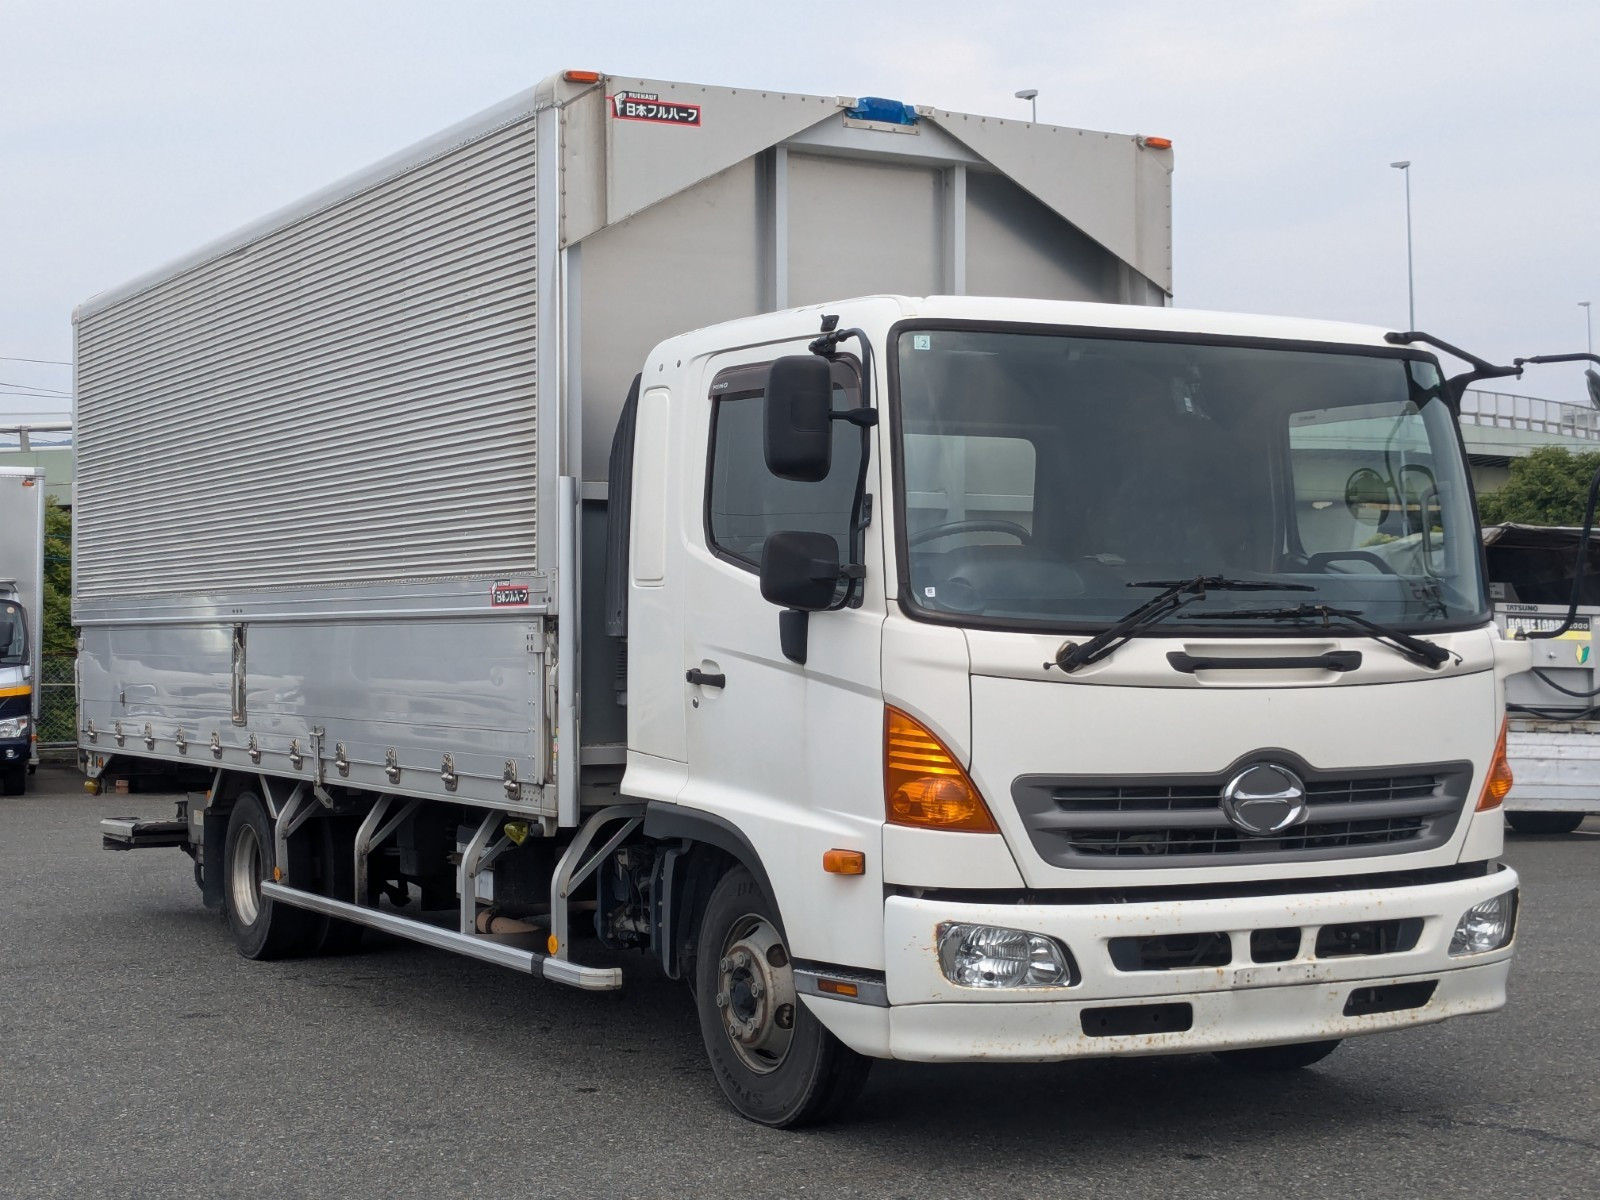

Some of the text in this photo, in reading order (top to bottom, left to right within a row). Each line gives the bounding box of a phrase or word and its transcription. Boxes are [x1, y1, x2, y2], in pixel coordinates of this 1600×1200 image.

[626, 103, 697, 121] 日本フルハーフ
[1505, 604, 1538, 612] TATSUNO
